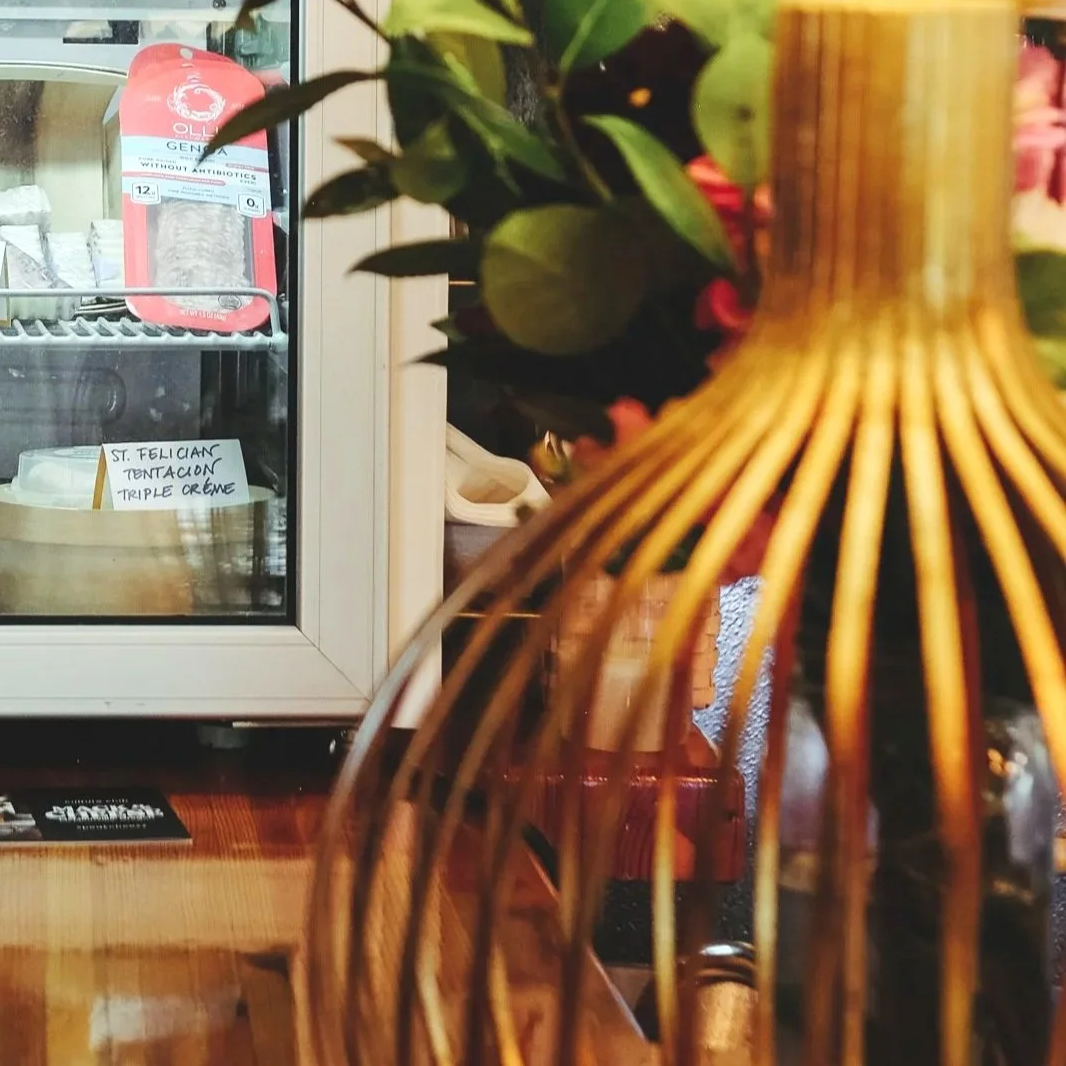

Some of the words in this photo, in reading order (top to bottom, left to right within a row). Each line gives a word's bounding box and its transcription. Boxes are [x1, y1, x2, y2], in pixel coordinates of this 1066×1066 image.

[167, 141, 228, 156] GENA
[140, 161, 188, 173] WITHOUT
[192, 168, 257, 181] ANTIBIOTICS
[111, 449, 130, 462] ST.
[137, 444, 220, 461] FELICIAN
[123, 458, 222, 481] TENTACION
[118, 485, 173, 502] TRIPLE
